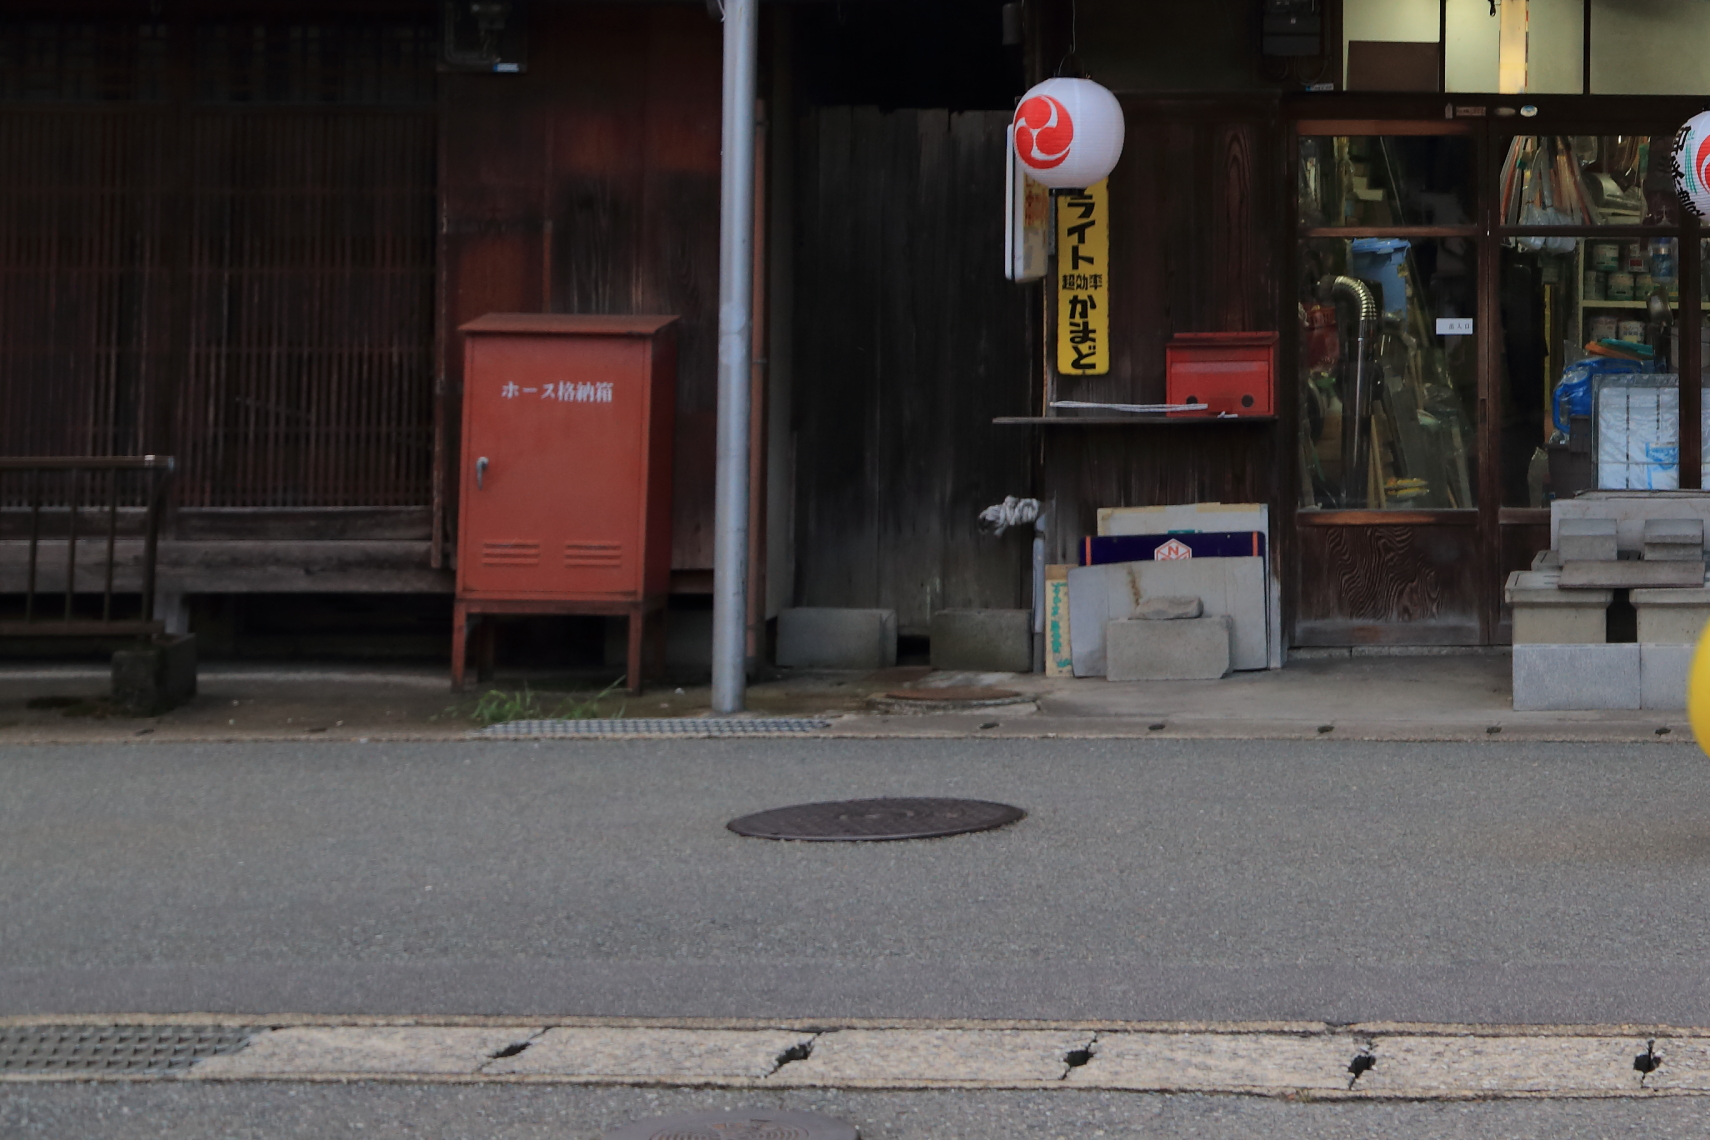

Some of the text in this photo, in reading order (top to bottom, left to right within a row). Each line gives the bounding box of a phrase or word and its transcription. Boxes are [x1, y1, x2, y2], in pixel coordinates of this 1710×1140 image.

[1062, 274, 1102, 291] 超効率
[1069, 294, 1097, 370] かまど
[501, 380, 614, 402] ホース格納箱
[1167, 546, 1179, 556] N
